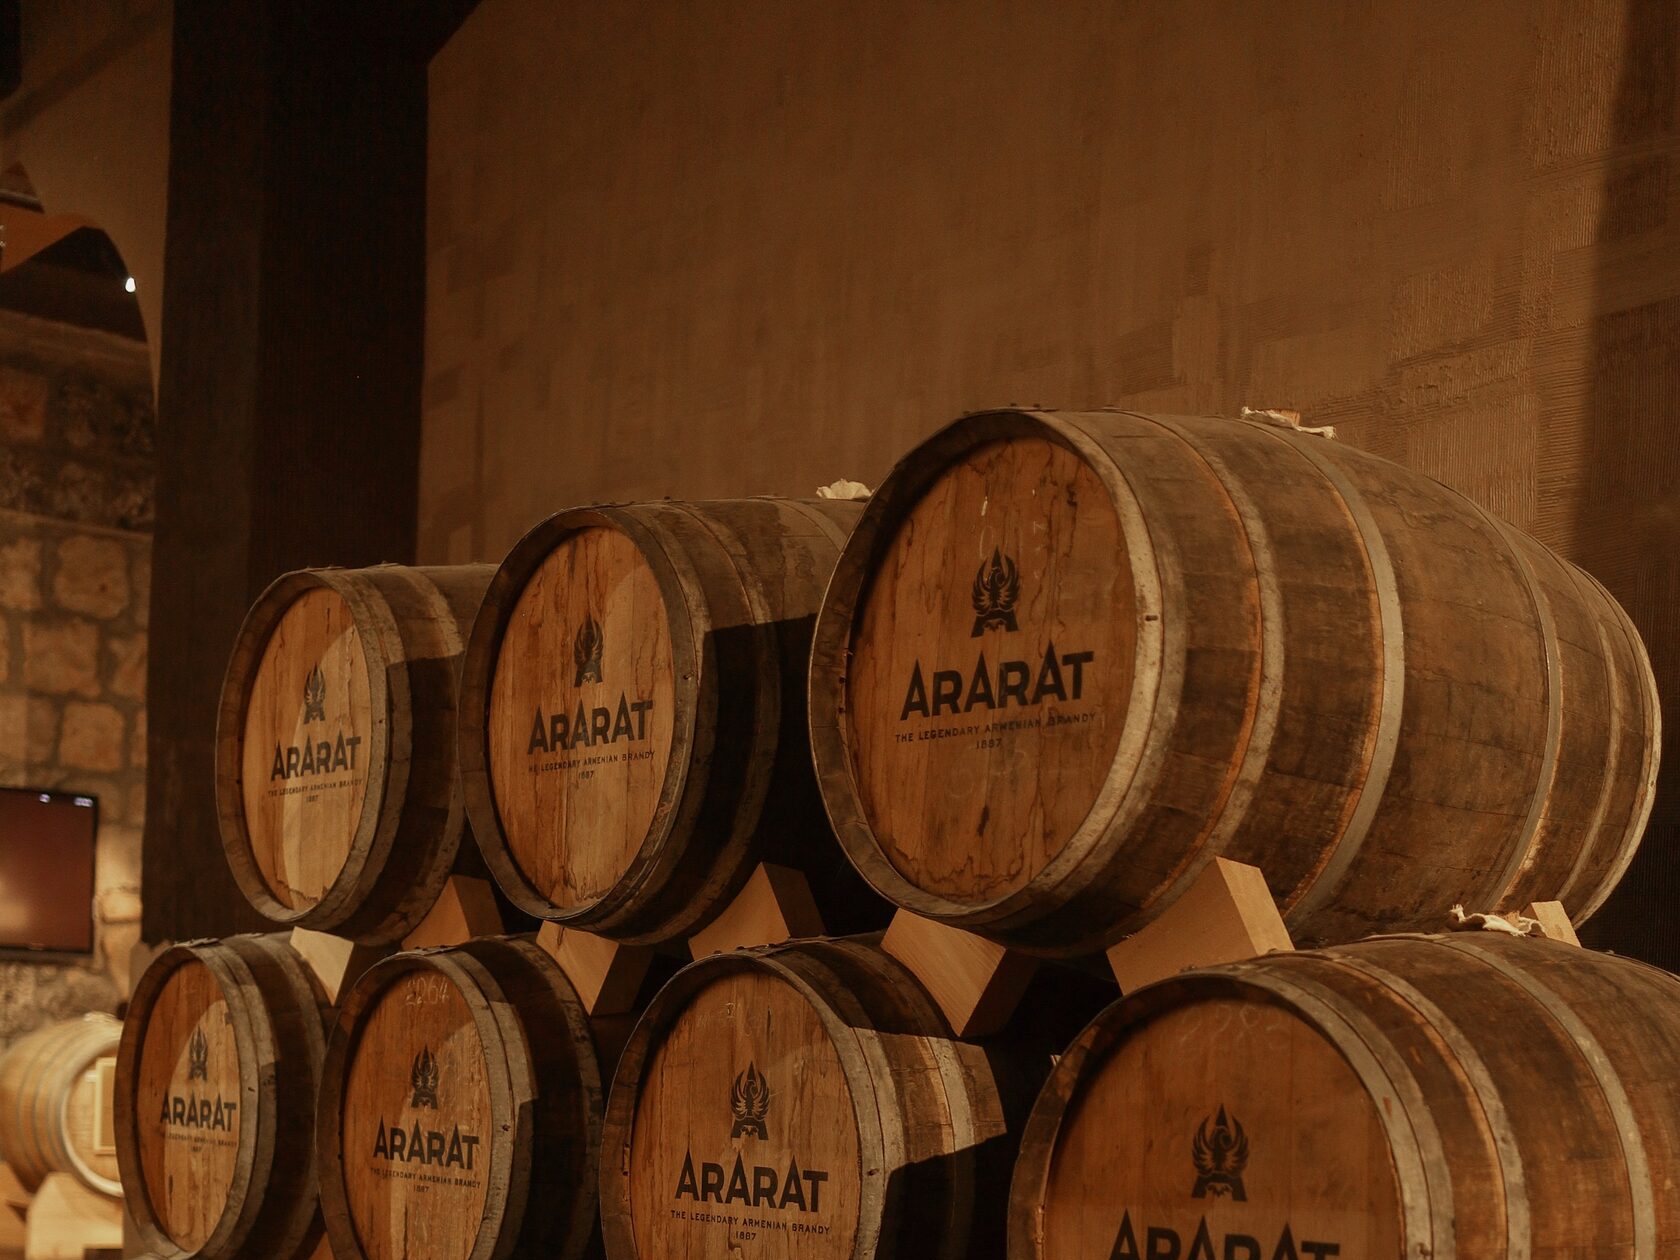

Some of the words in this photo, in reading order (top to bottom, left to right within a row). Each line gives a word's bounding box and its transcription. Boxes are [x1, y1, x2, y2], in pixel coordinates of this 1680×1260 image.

[900, 639, 1094, 720] ARARAT
[527, 690, 653, 755] ARARAT
[895, 732, 913, 743] THE
[918, 725, 980, 741] LEGENDARY
[984, 719, 1041, 733] ARMENIAN
[1047, 712, 1096, 727] BRANDY
[976, 738, 1003, 749] 1887
[271, 729, 361, 782] ARARAT
[584, 756, 618, 766] ARMENIAN
[622, 751, 655, 762] BRANDY
[160, 1089, 236, 1132] ARARAT
[373, 1114, 479, 1170] ARARAT
[675, 1147, 828, 1213] ARARAT
[671, 1209, 686, 1220] THE
[690, 1212, 738, 1225] LEGENDARY
[742, 1218, 787, 1231] ARMENIAN
[792, 1223, 830, 1235] BRANDY
[735, 1231, 757, 1241] 1887
